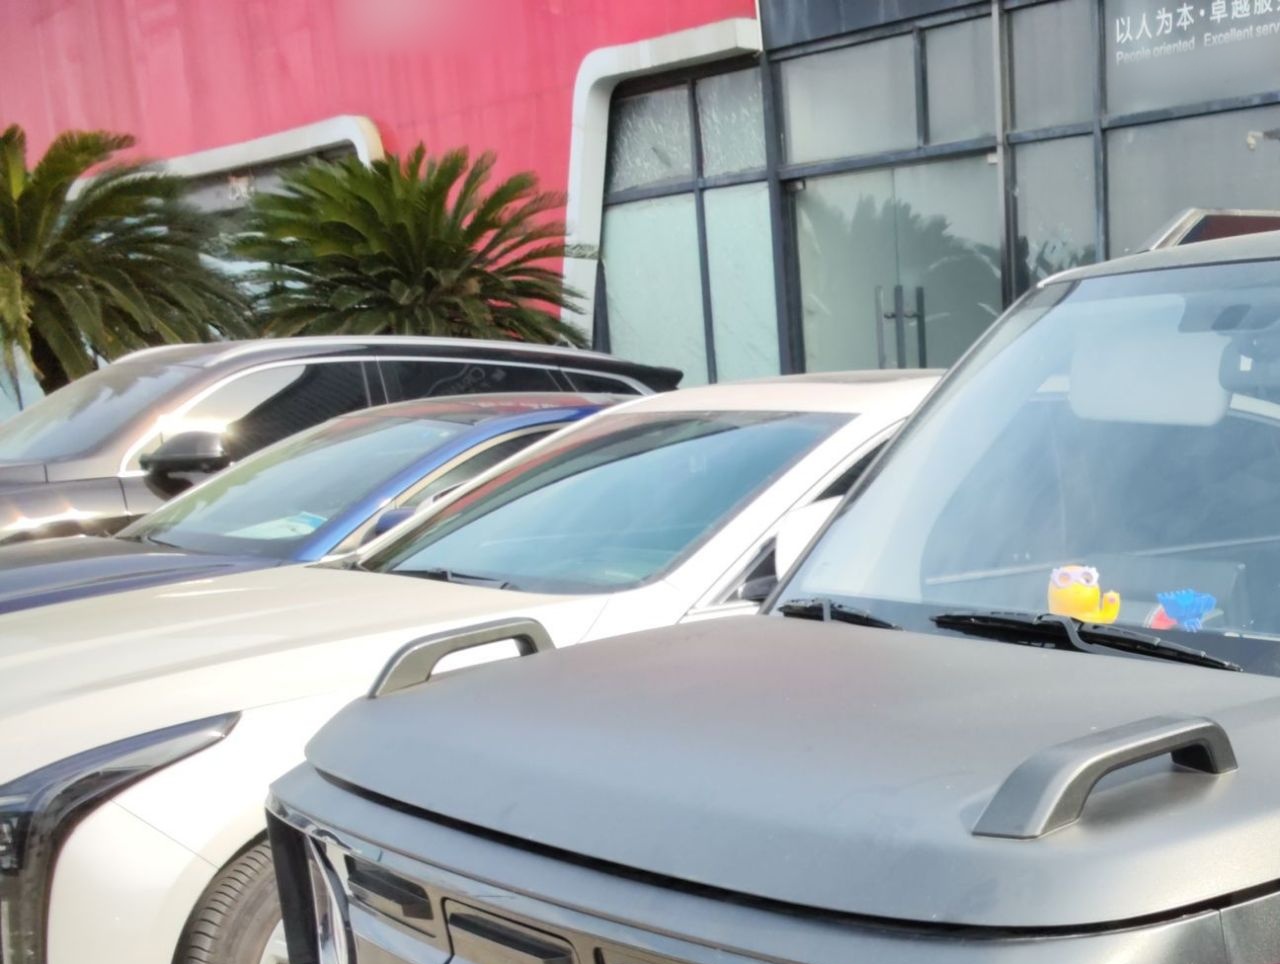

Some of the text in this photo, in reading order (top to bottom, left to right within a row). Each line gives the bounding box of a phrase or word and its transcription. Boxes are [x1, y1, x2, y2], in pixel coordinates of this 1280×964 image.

[1115, 46, 1152, 66] People
[1152, 36, 1196, 58] oriented
[1203, 25, 1254, 47] Excellent
